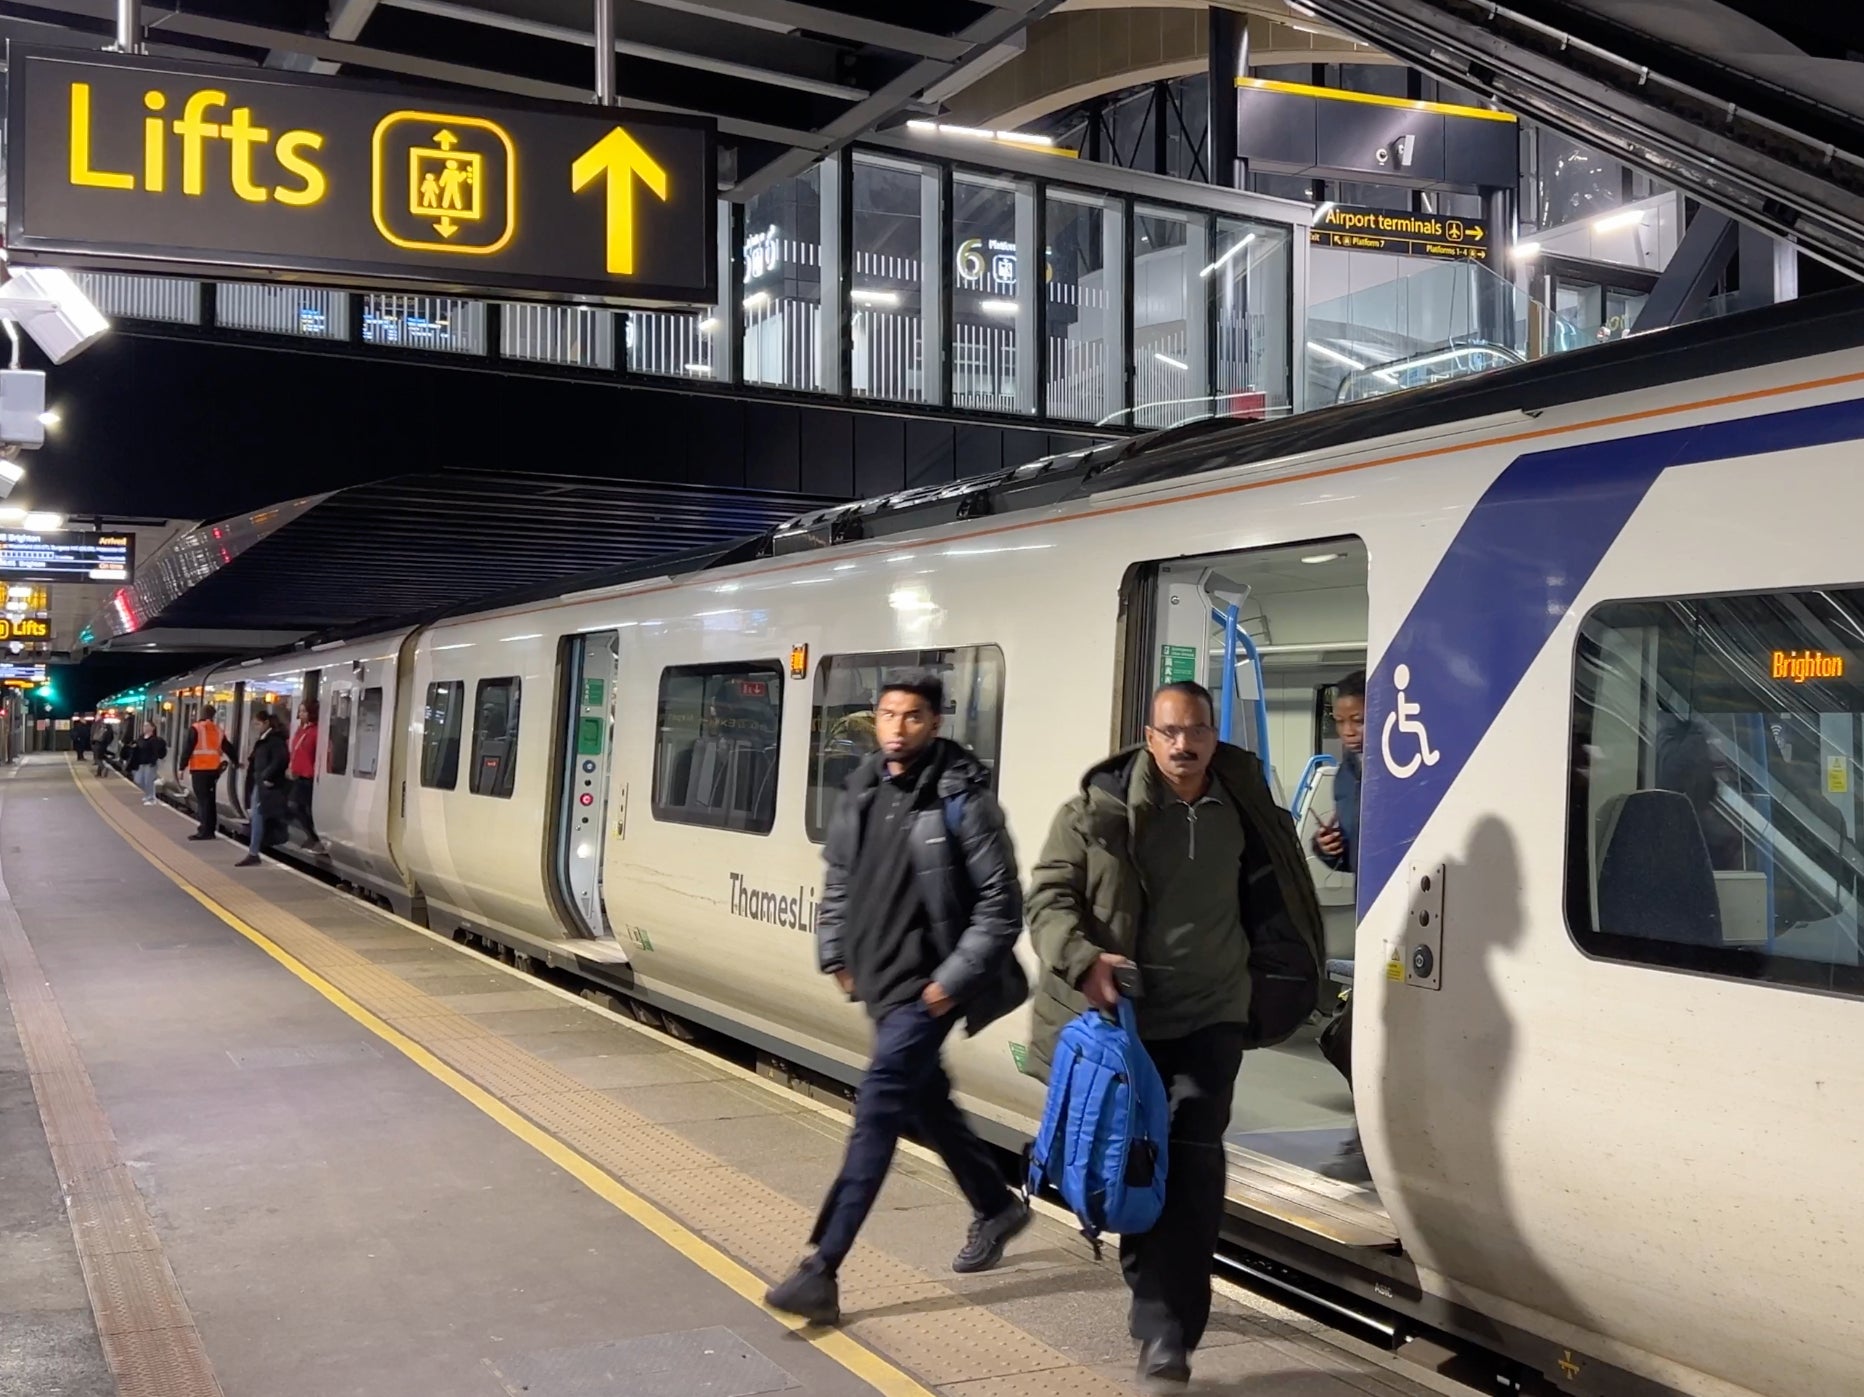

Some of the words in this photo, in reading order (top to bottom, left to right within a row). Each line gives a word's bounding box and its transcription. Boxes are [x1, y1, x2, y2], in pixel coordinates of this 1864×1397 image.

[70, 82, 328, 206] Lifts
[1325, 209, 1375, 229] Airport
[1379, 214, 1442, 235] terminals
[1352, 237, 1379, 248] Platform
[1380, 240, 1385, 248] 7
[1426, 245, 1455, 255] Platforms
[957, 239, 985, 280] 6
[13, 620, 46, 636] Lifts
[1773, 651, 1843, 683] Brighton
